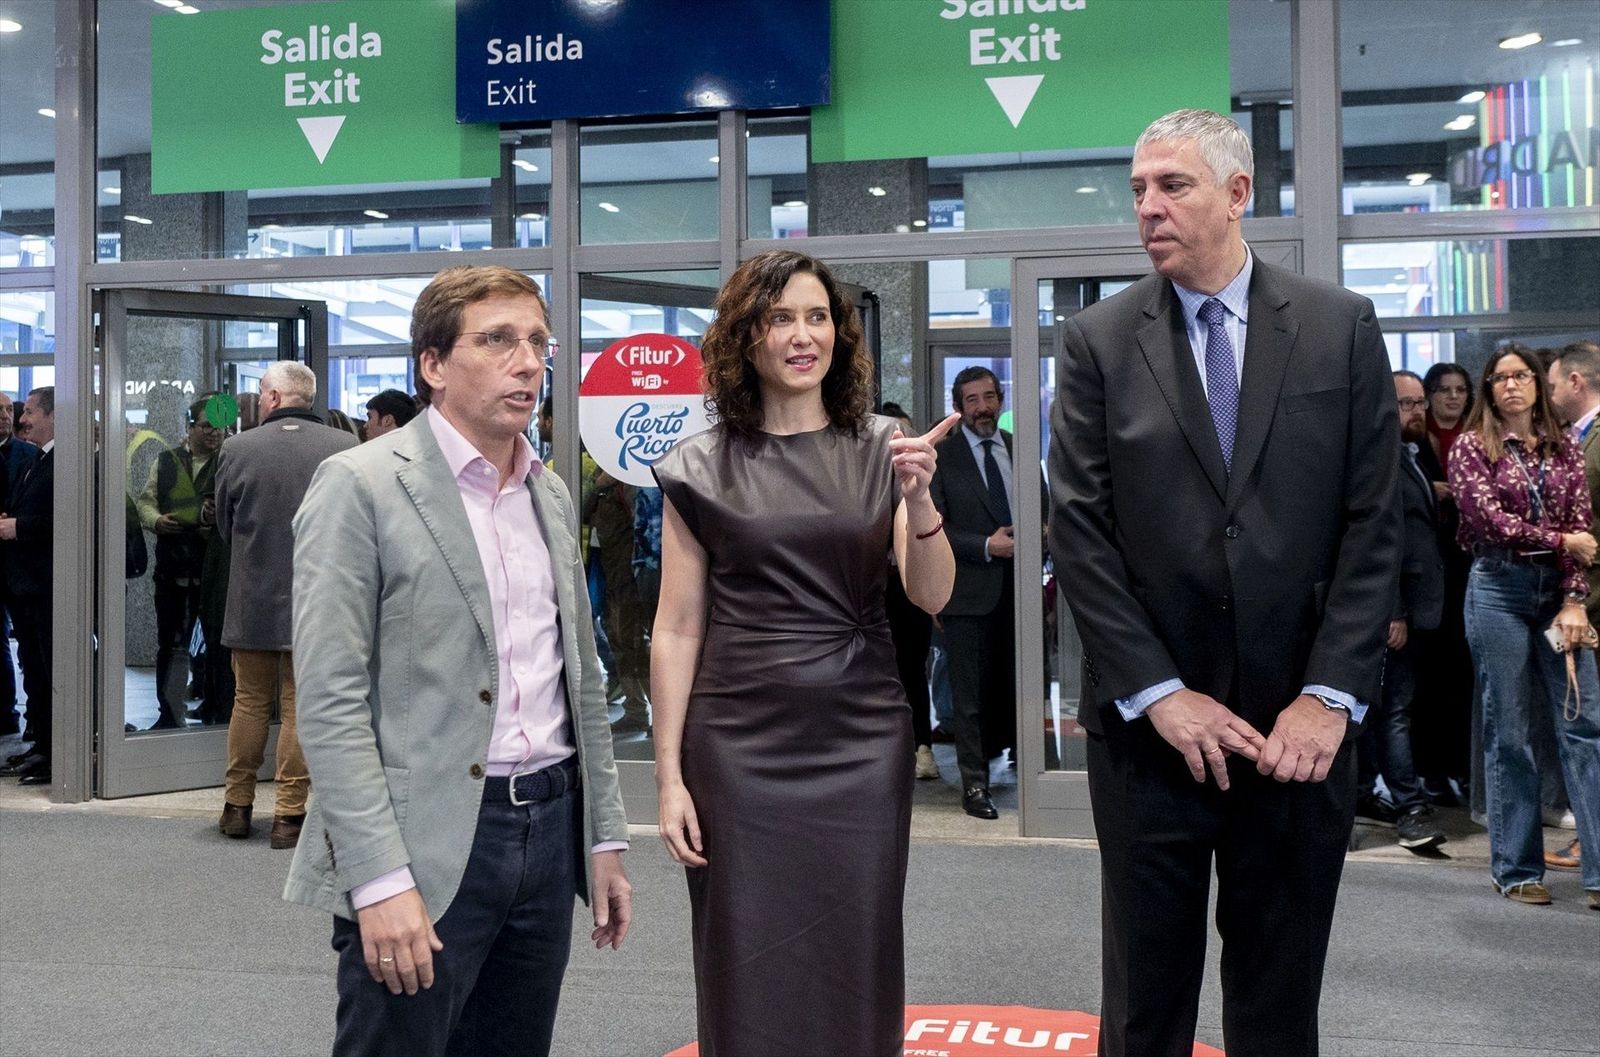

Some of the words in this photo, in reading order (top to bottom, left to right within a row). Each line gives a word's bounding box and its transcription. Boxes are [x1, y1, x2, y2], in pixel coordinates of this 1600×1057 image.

[260, 22, 382, 65] Salida
[487, 33, 583, 65] Salida
[969, 23, 1062, 65] Exit
[284, 68, 361, 107] Exit
[487, 77, 537, 106] Exit
[630, 346, 672, 365] Fitur
[615, 402, 689, 440] Puerto
[618, 434, 677, 471] Rico
[904, 1018, 1089, 1050] Fitur
